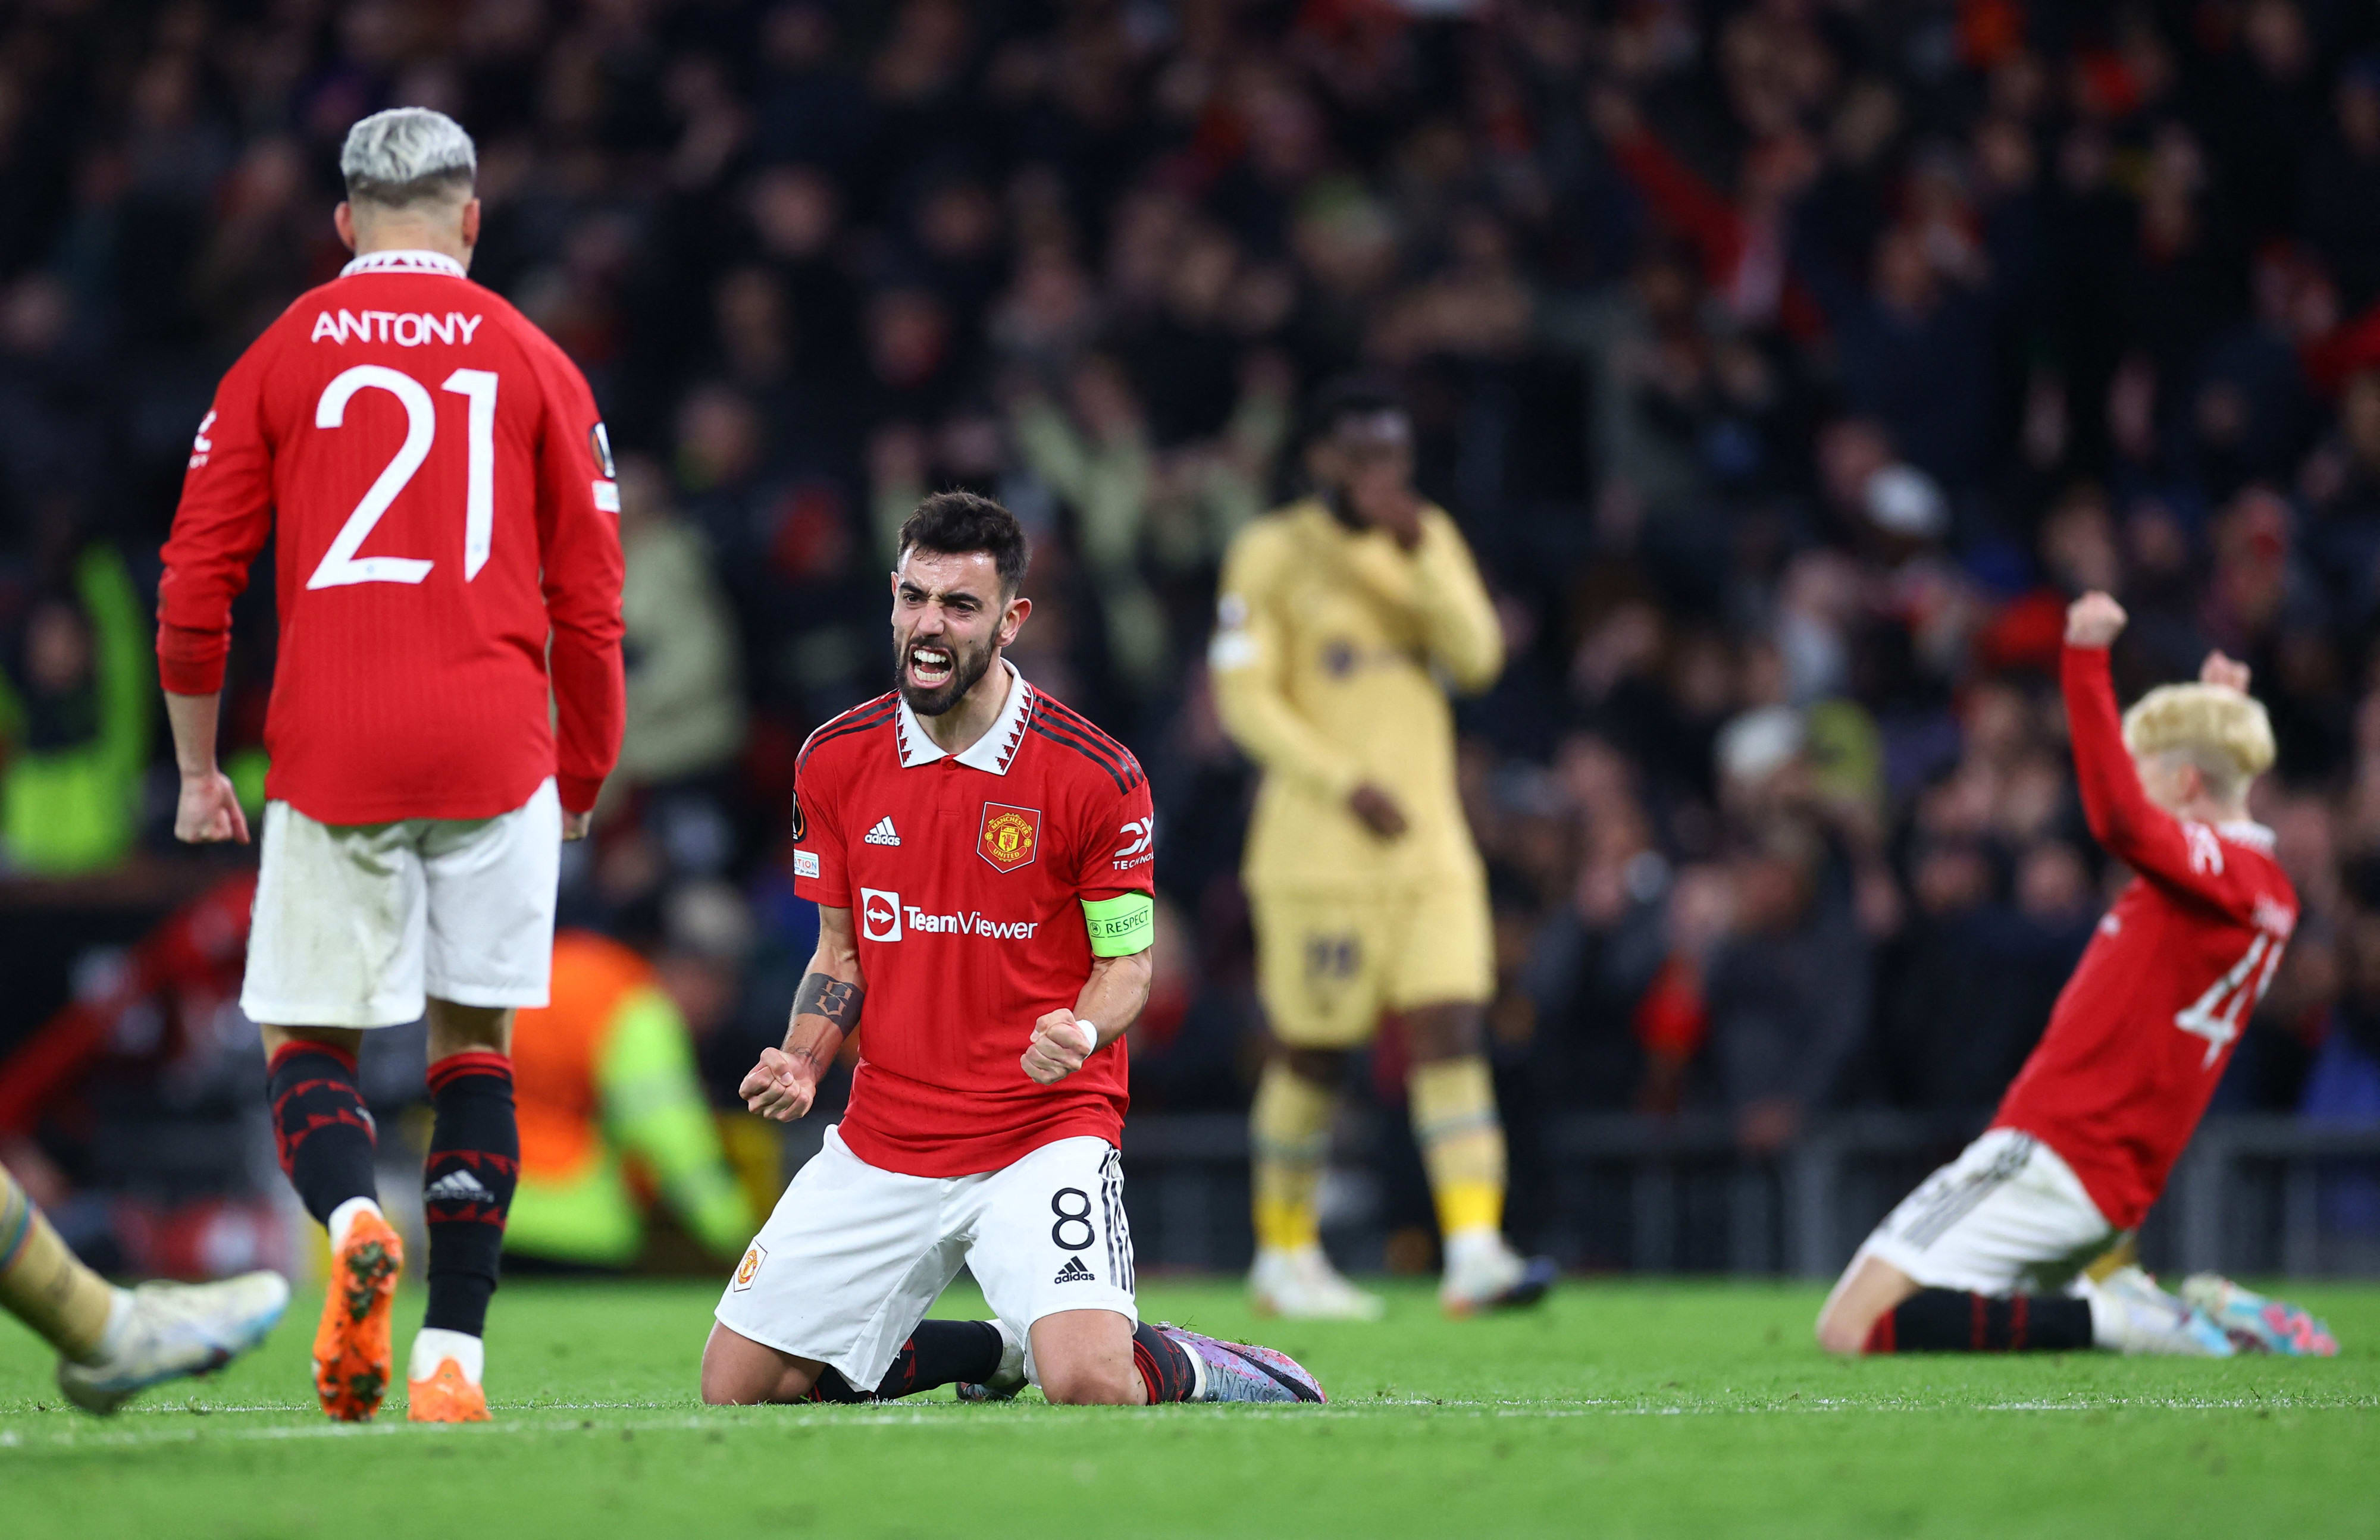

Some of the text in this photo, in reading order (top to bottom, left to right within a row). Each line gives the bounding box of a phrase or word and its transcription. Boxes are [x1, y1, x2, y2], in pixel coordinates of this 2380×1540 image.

[311, 308, 483, 347] ANTONY
[305, 364, 499, 590] 21
[991, 816, 1029, 835] MANCHESTER
[864, 833, 901, 846] adidas
[992, 848, 1020, 859] UNITED
[903, 905, 1038, 940] TeamViewer
[1105, 909, 1149, 934] RESPECT
[1051, 1187, 1095, 1251] 8
[1054, 1271, 1095, 1285] adidas
